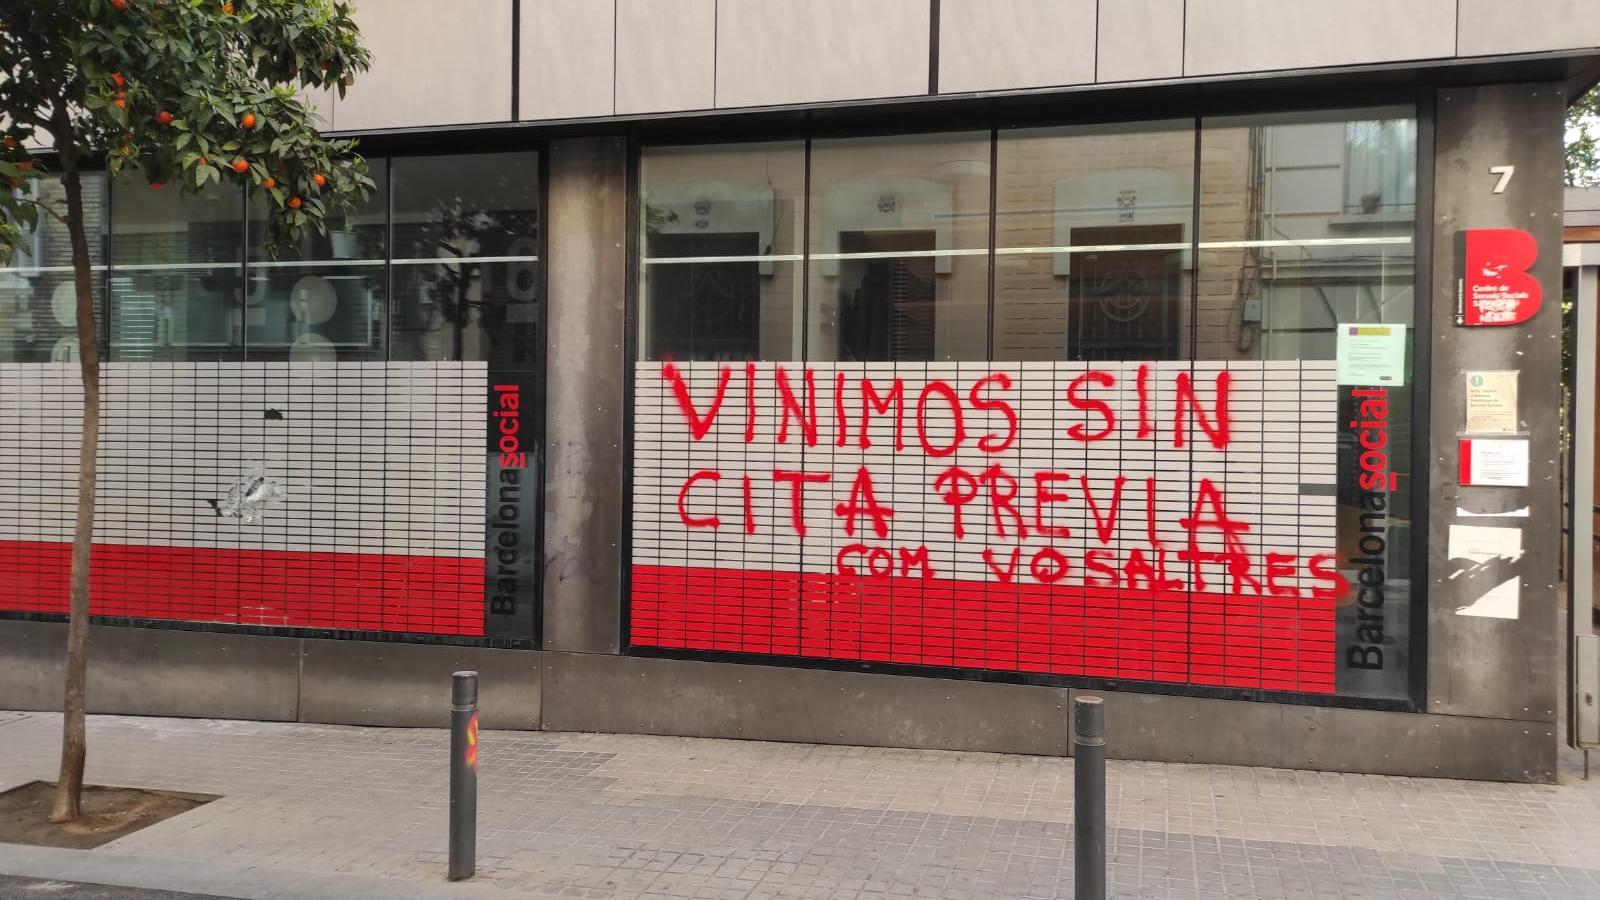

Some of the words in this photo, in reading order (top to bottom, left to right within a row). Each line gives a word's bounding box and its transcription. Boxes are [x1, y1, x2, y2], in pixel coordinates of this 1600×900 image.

[1489, 165, 1514, 193] 7
[661, 361, 1018, 458] VINIMOS
[1066, 364, 1231, 450] SIN
[677, 465, 894, 540] CITA
[934, 463, 1251, 546] PREVIA
[836, 543, 936, 579] COM
[982, 547, 1350, 599] VOSALTRES
